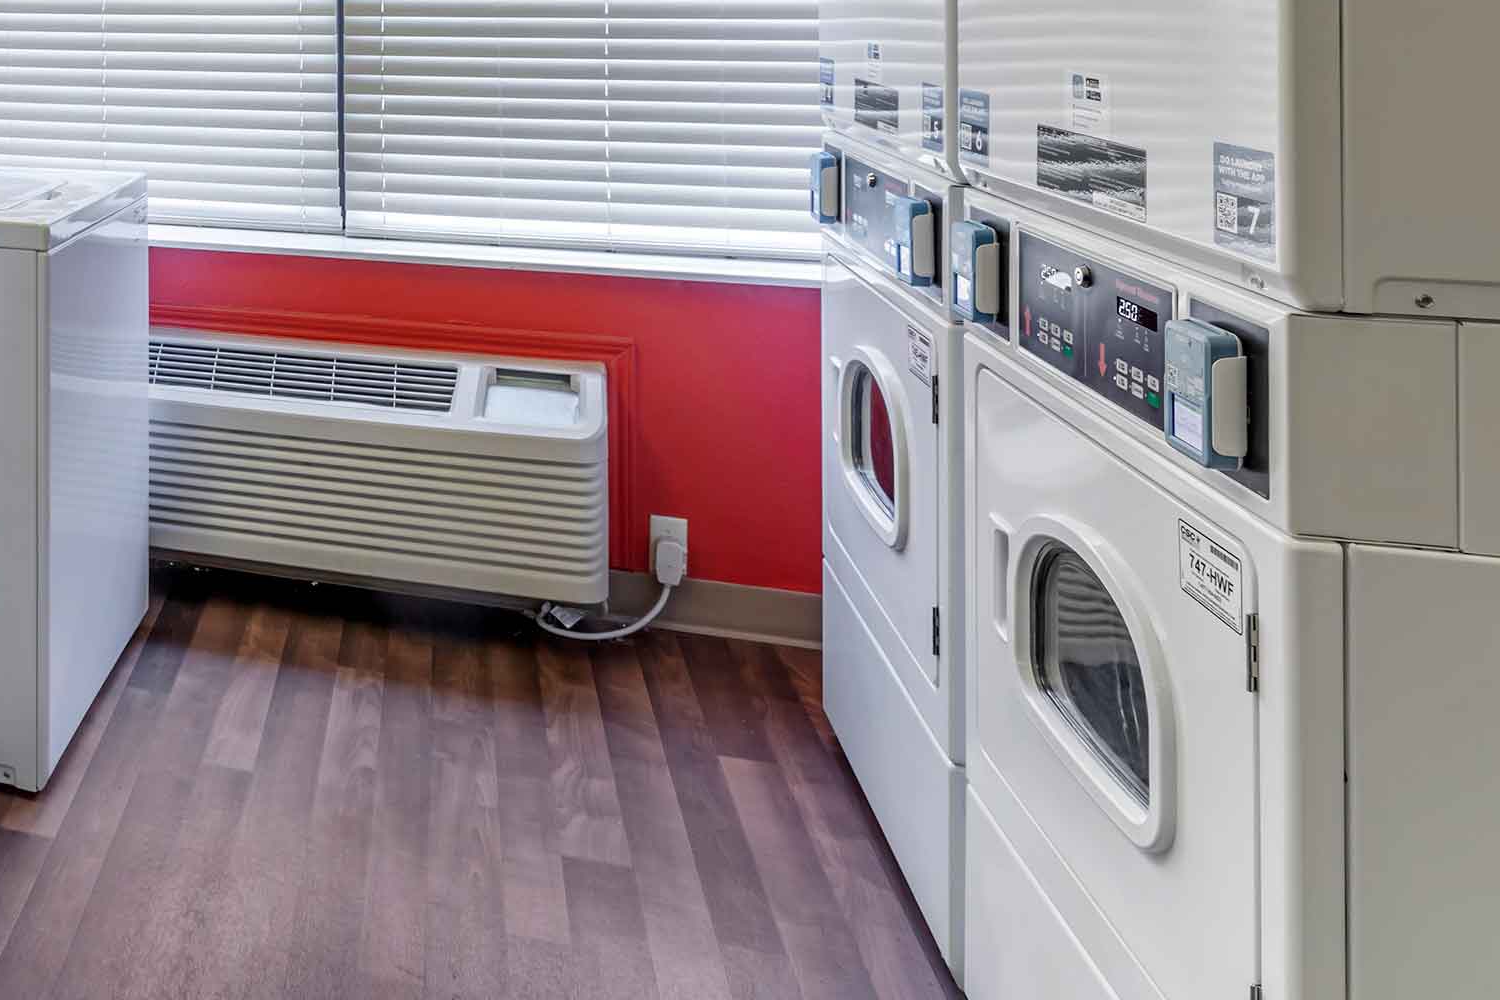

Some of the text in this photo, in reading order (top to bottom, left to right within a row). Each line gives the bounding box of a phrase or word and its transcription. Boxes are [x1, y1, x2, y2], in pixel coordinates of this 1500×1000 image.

[975, 130, 983, 151] 6
[1247, 206, 1260, 235] 7
[1189, 552, 1235, 597] 747-HWF
